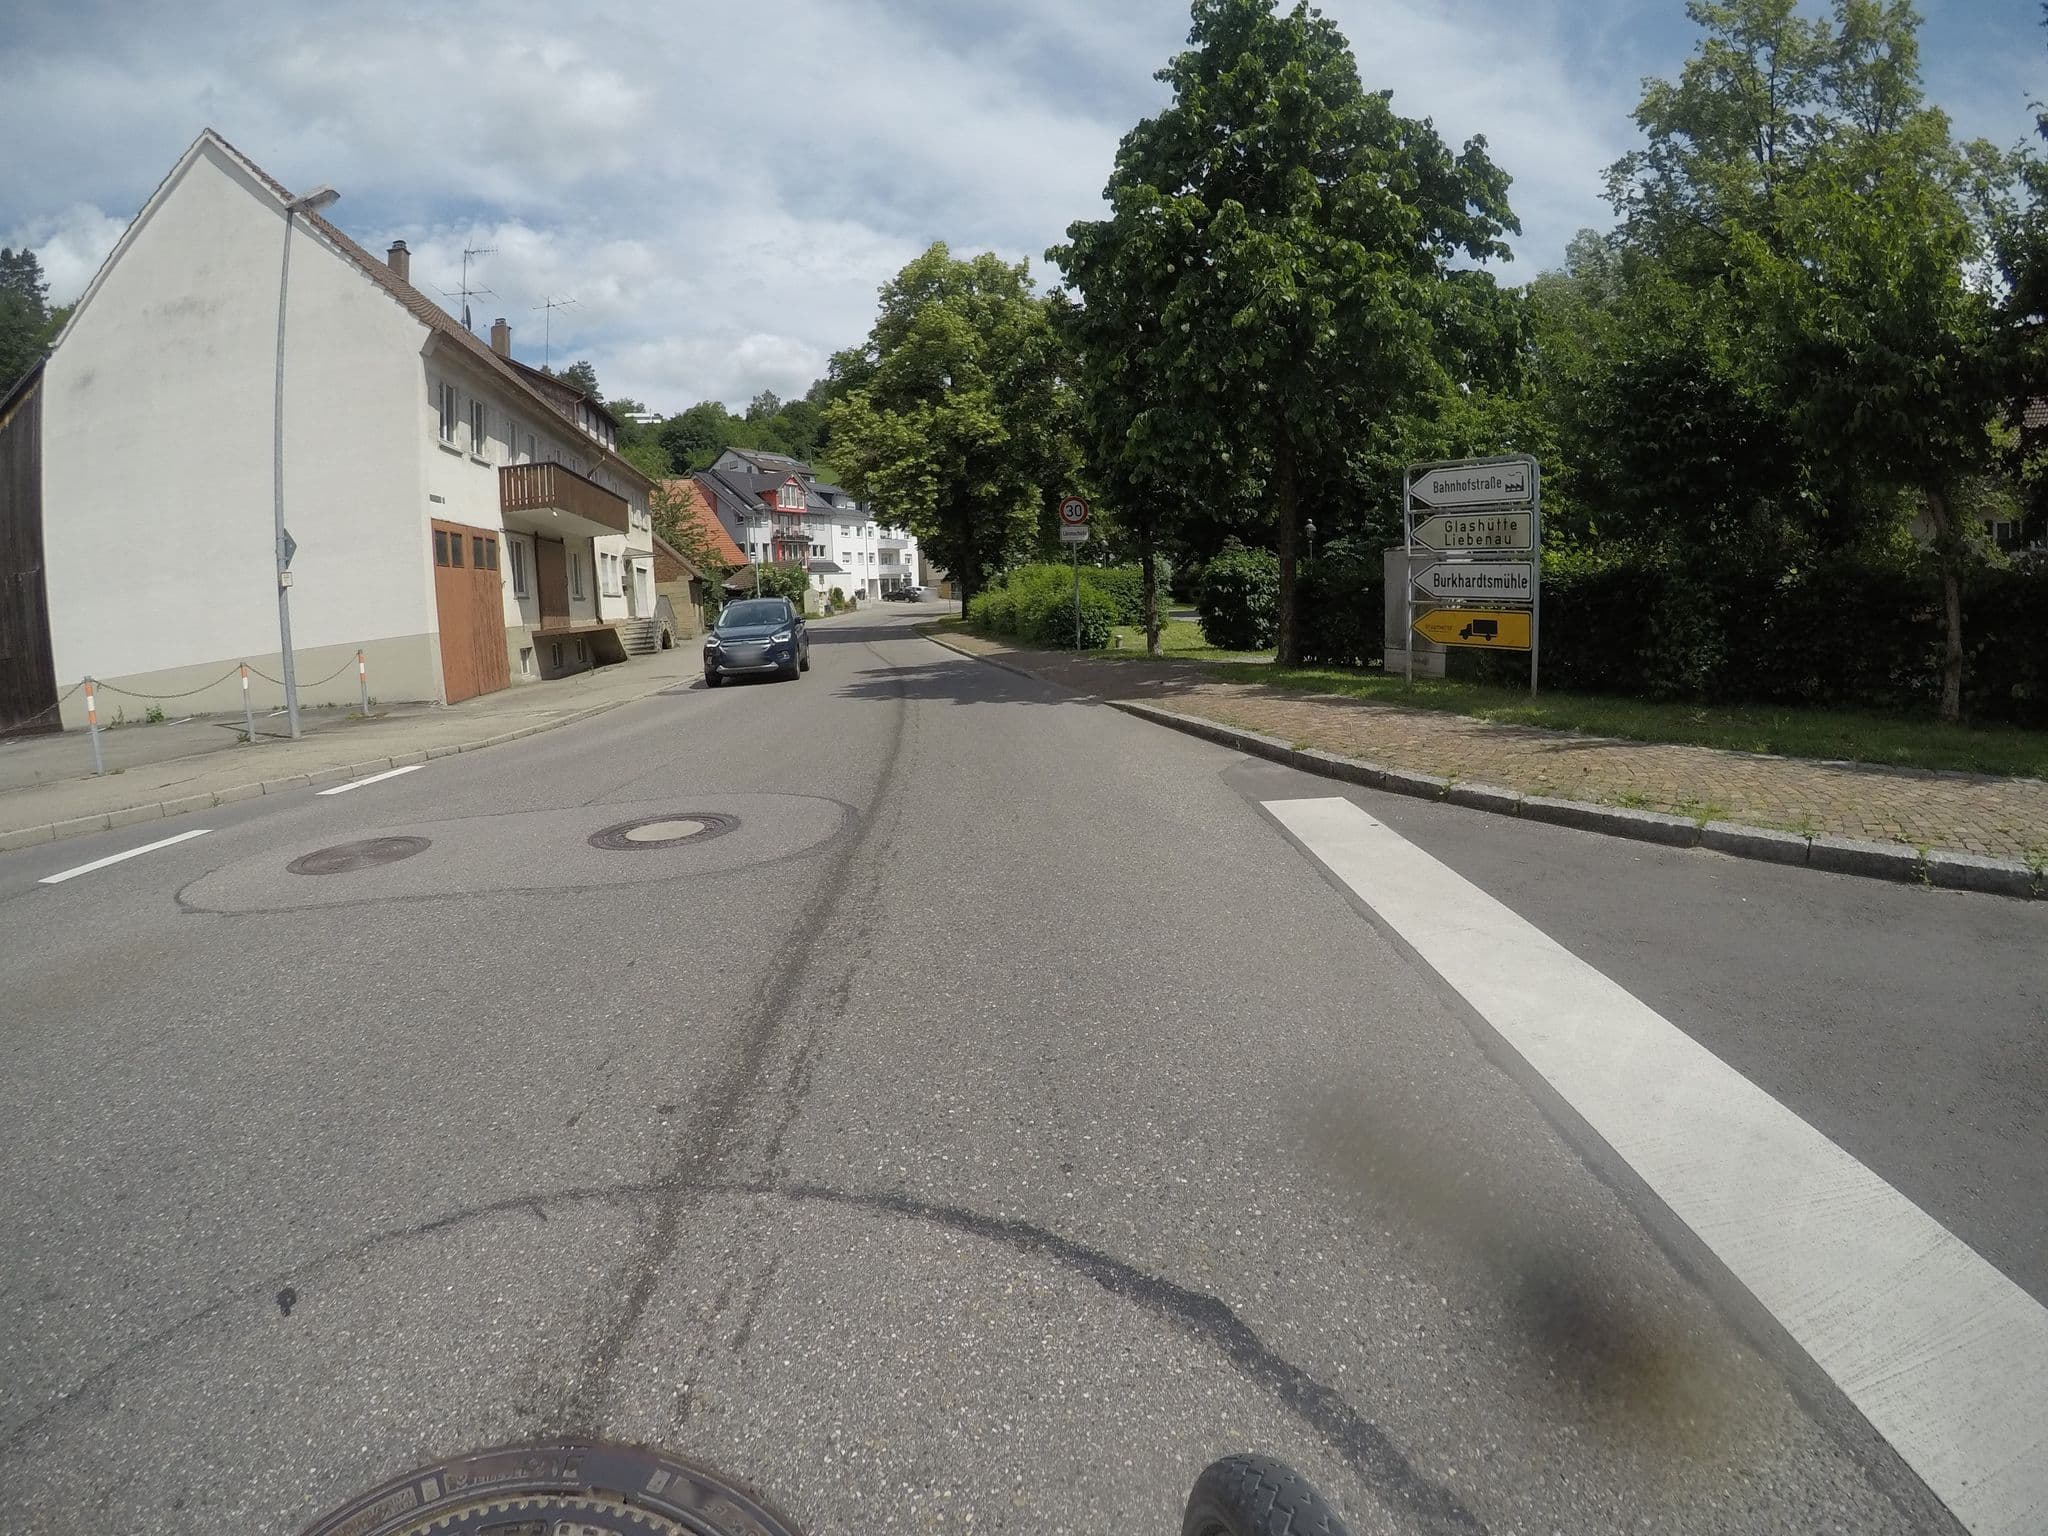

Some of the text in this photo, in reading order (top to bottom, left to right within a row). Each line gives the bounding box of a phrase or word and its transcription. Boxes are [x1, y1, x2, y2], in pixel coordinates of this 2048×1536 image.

[1433, 476, 1502, 493] Bahnhofstraße
[1066, 504, 1082, 517] 30
[1444, 518, 1518, 532] Glashütte
[1444, 532, 1512, 546] Liebenau
[1433, 573, 1528, 589] Burkhardtsmühle
